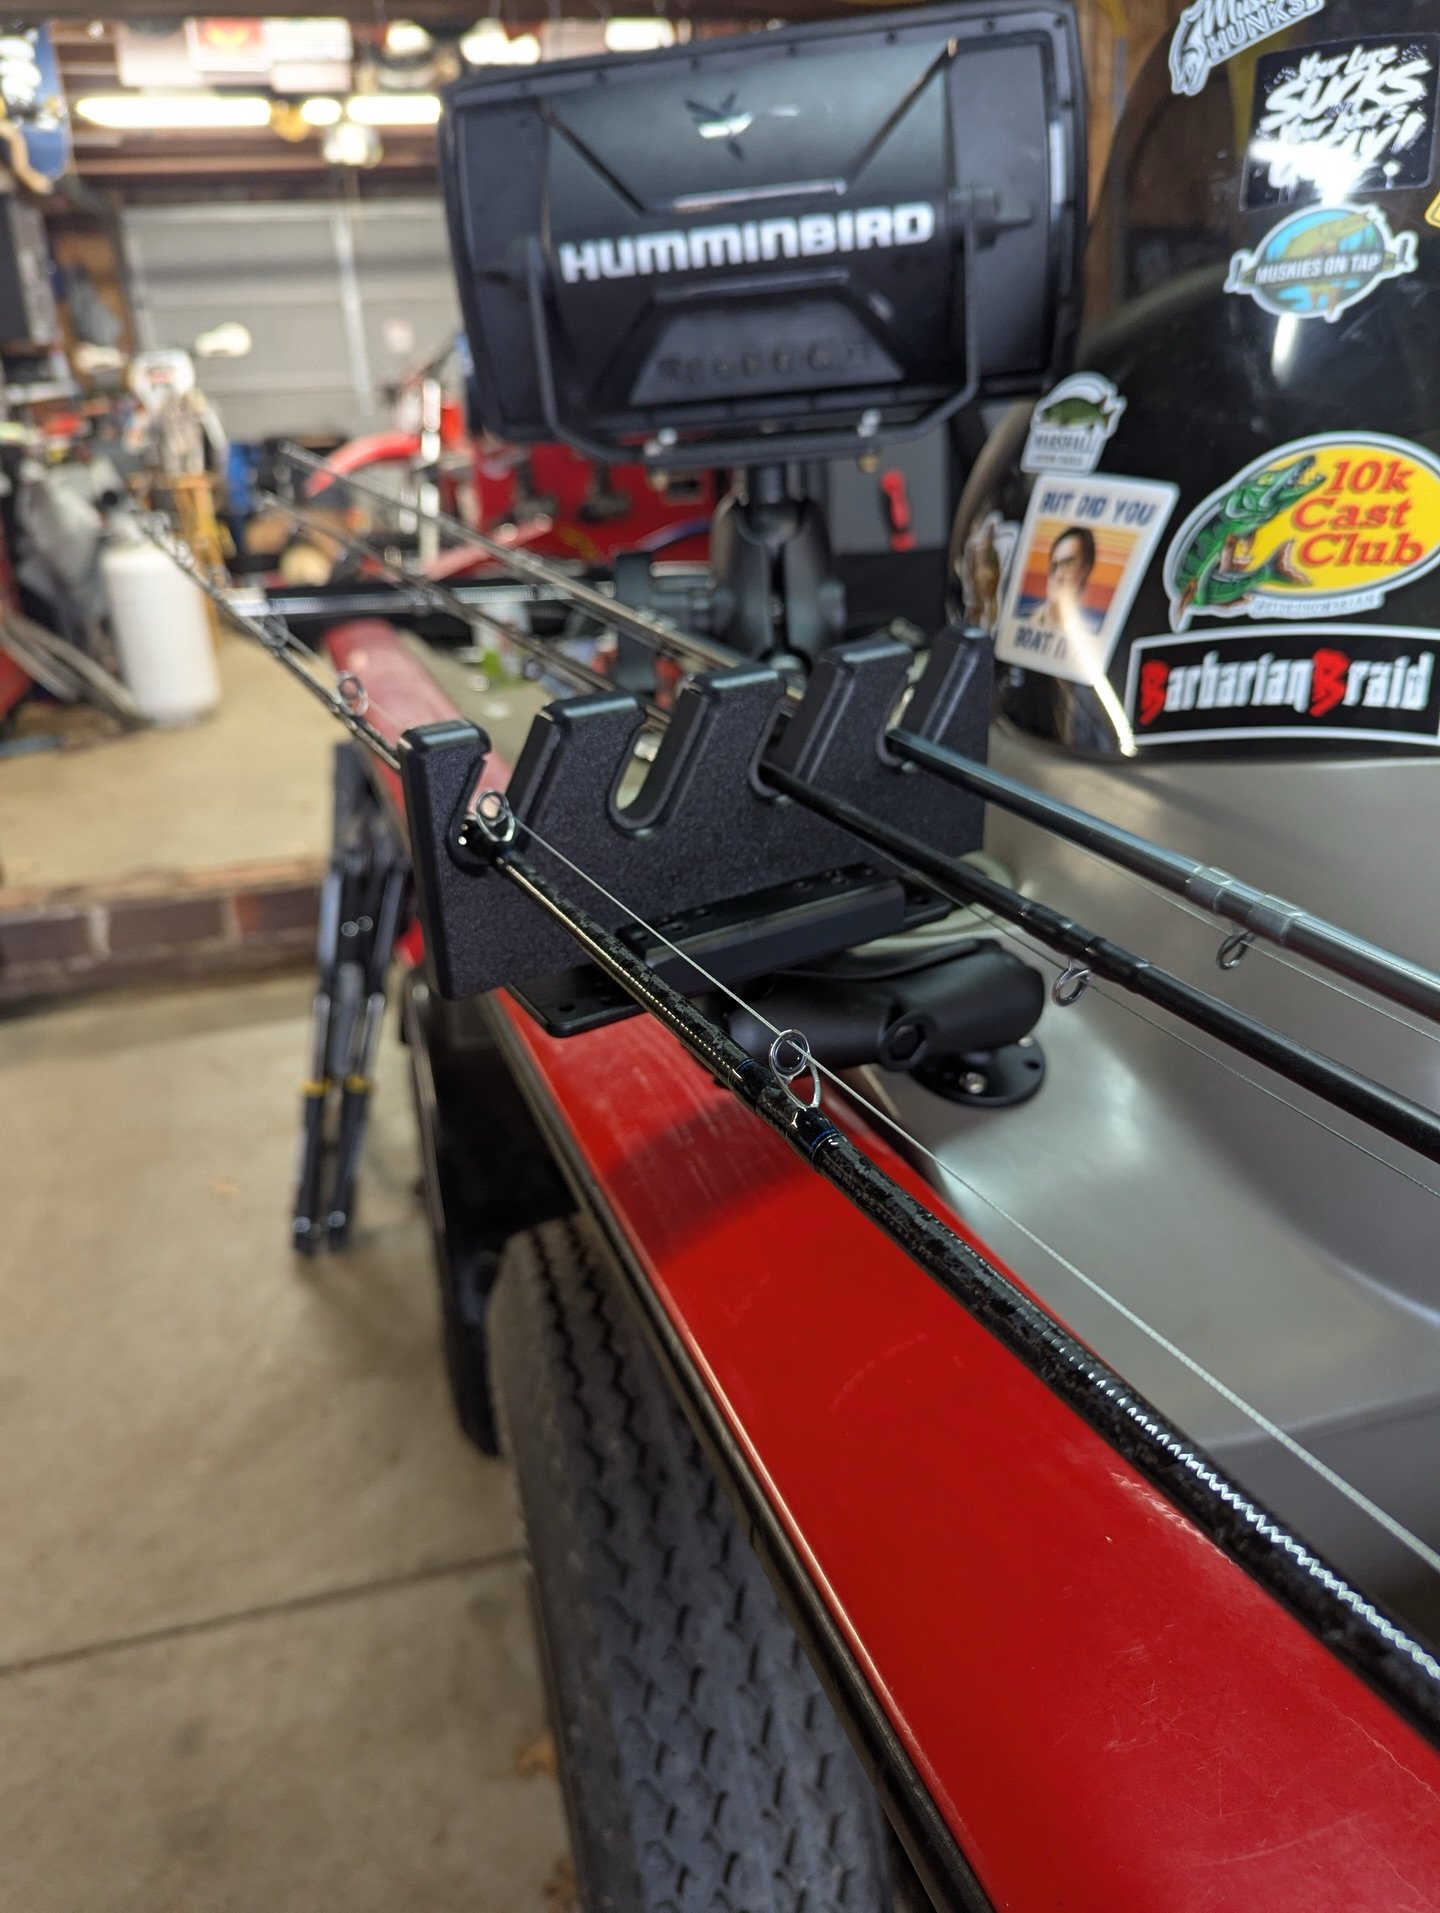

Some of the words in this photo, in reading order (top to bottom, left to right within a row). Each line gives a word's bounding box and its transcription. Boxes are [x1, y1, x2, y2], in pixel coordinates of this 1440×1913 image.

[1259, 60, 1432, 133] SUCKS
[558, 201, 935, 284] HUMMINBIRD
[1255, 258, 1324, 285] MUSKIES
[1324, 255, 1348, 276] ON
[1350, 252, 1382, 273] TAP
[1323, 460, 1416, 495] 10k
[1040, 489, 1074, 515] BUT
[1075, 493, 1108, 519] DID
[1111, 498, 1157, 528] YOU
[1290, 496, 1413, 532] Cast
[1298, 532, 1424, 568] Club
